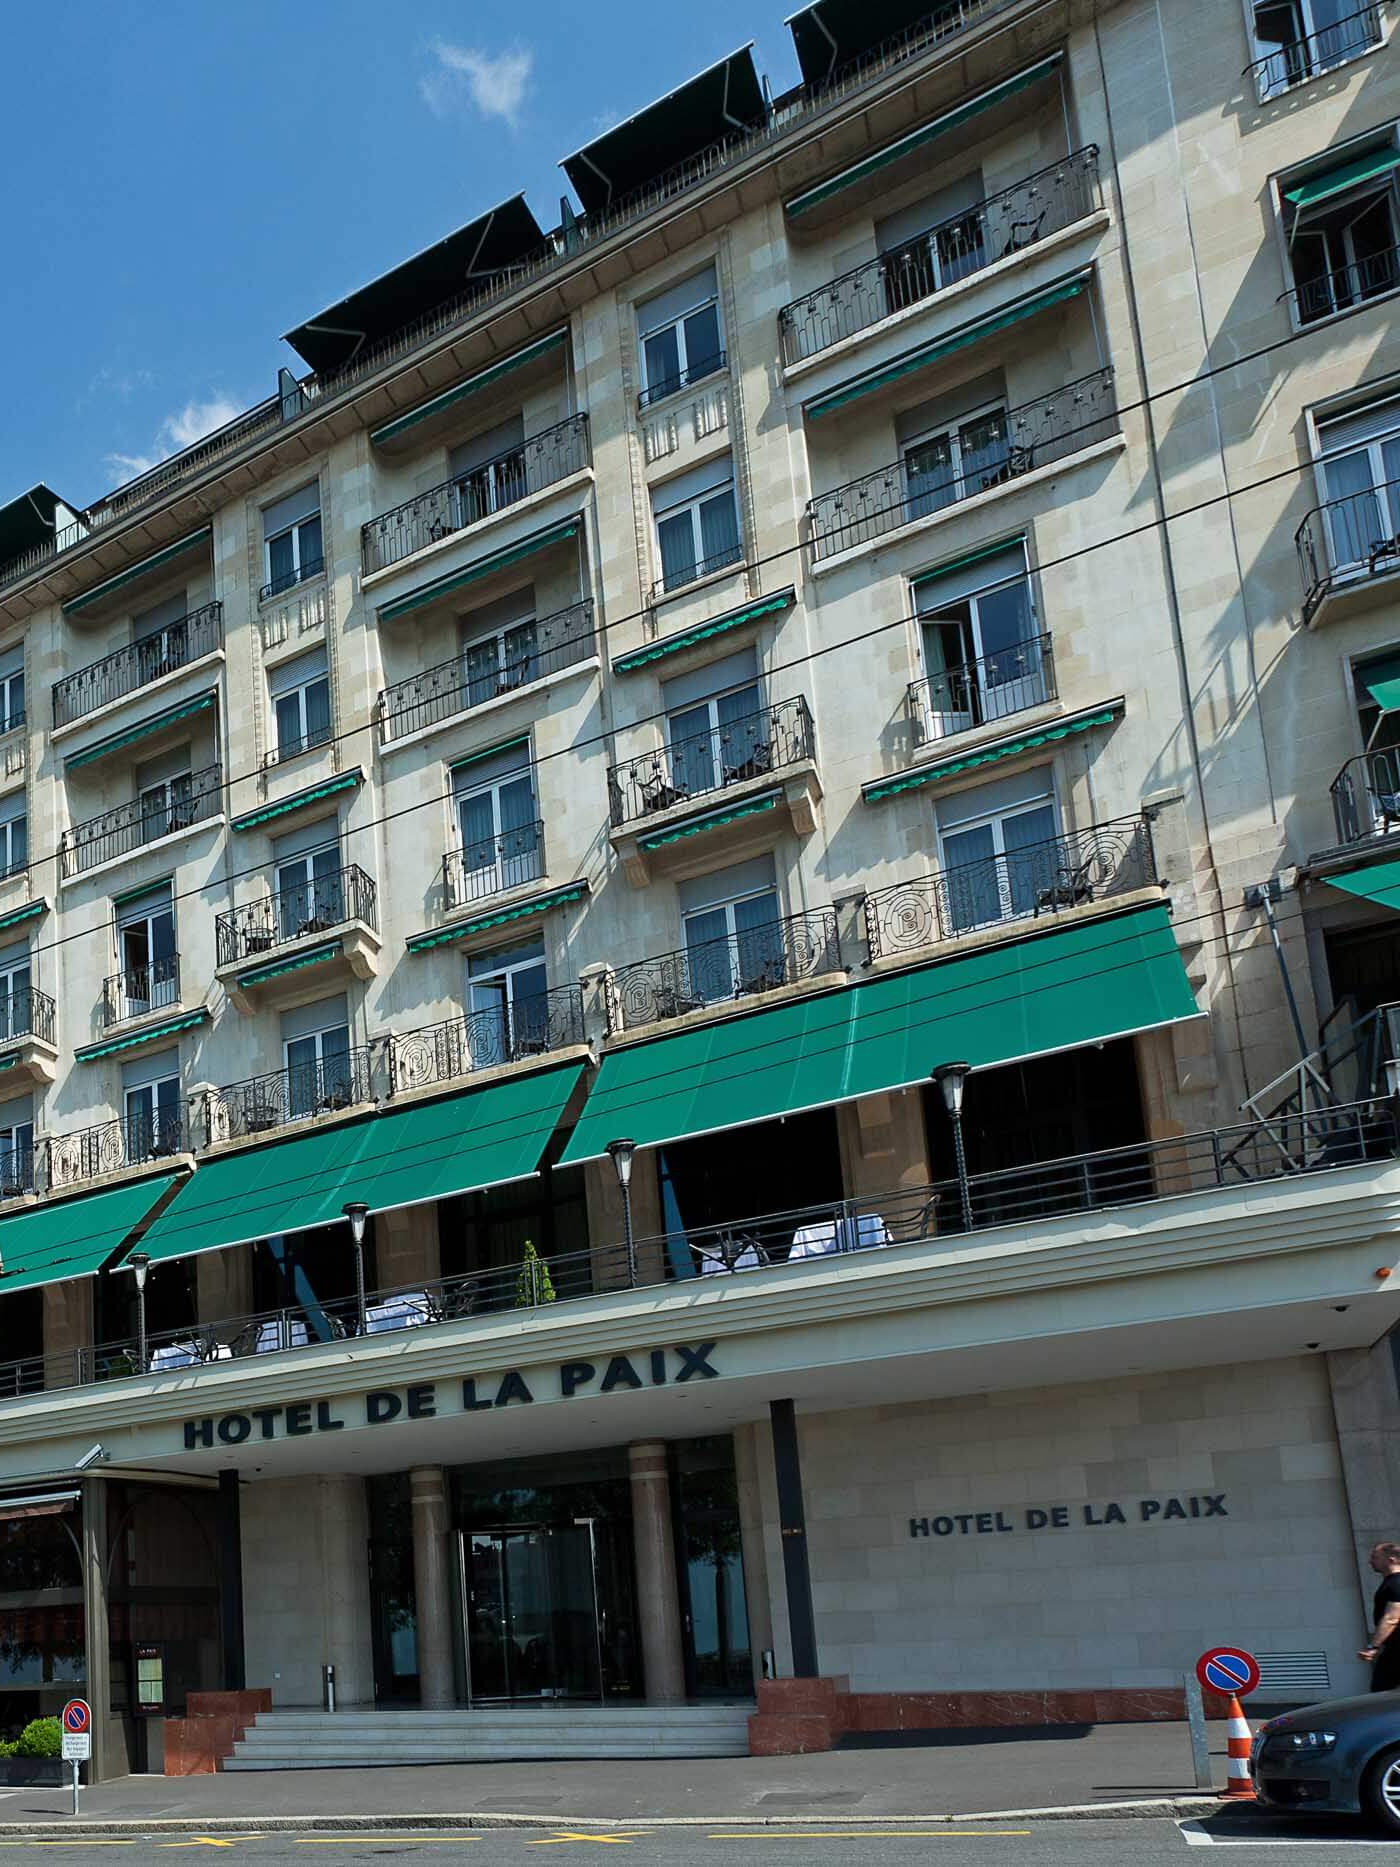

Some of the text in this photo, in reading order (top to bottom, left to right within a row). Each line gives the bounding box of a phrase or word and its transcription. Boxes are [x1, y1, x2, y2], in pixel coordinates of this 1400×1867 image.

[184, 1342, 720, 1449] HOTEL DE LA PAIX
[909, 1494, 1229, 1538] HOTEL DE LA PAIX
